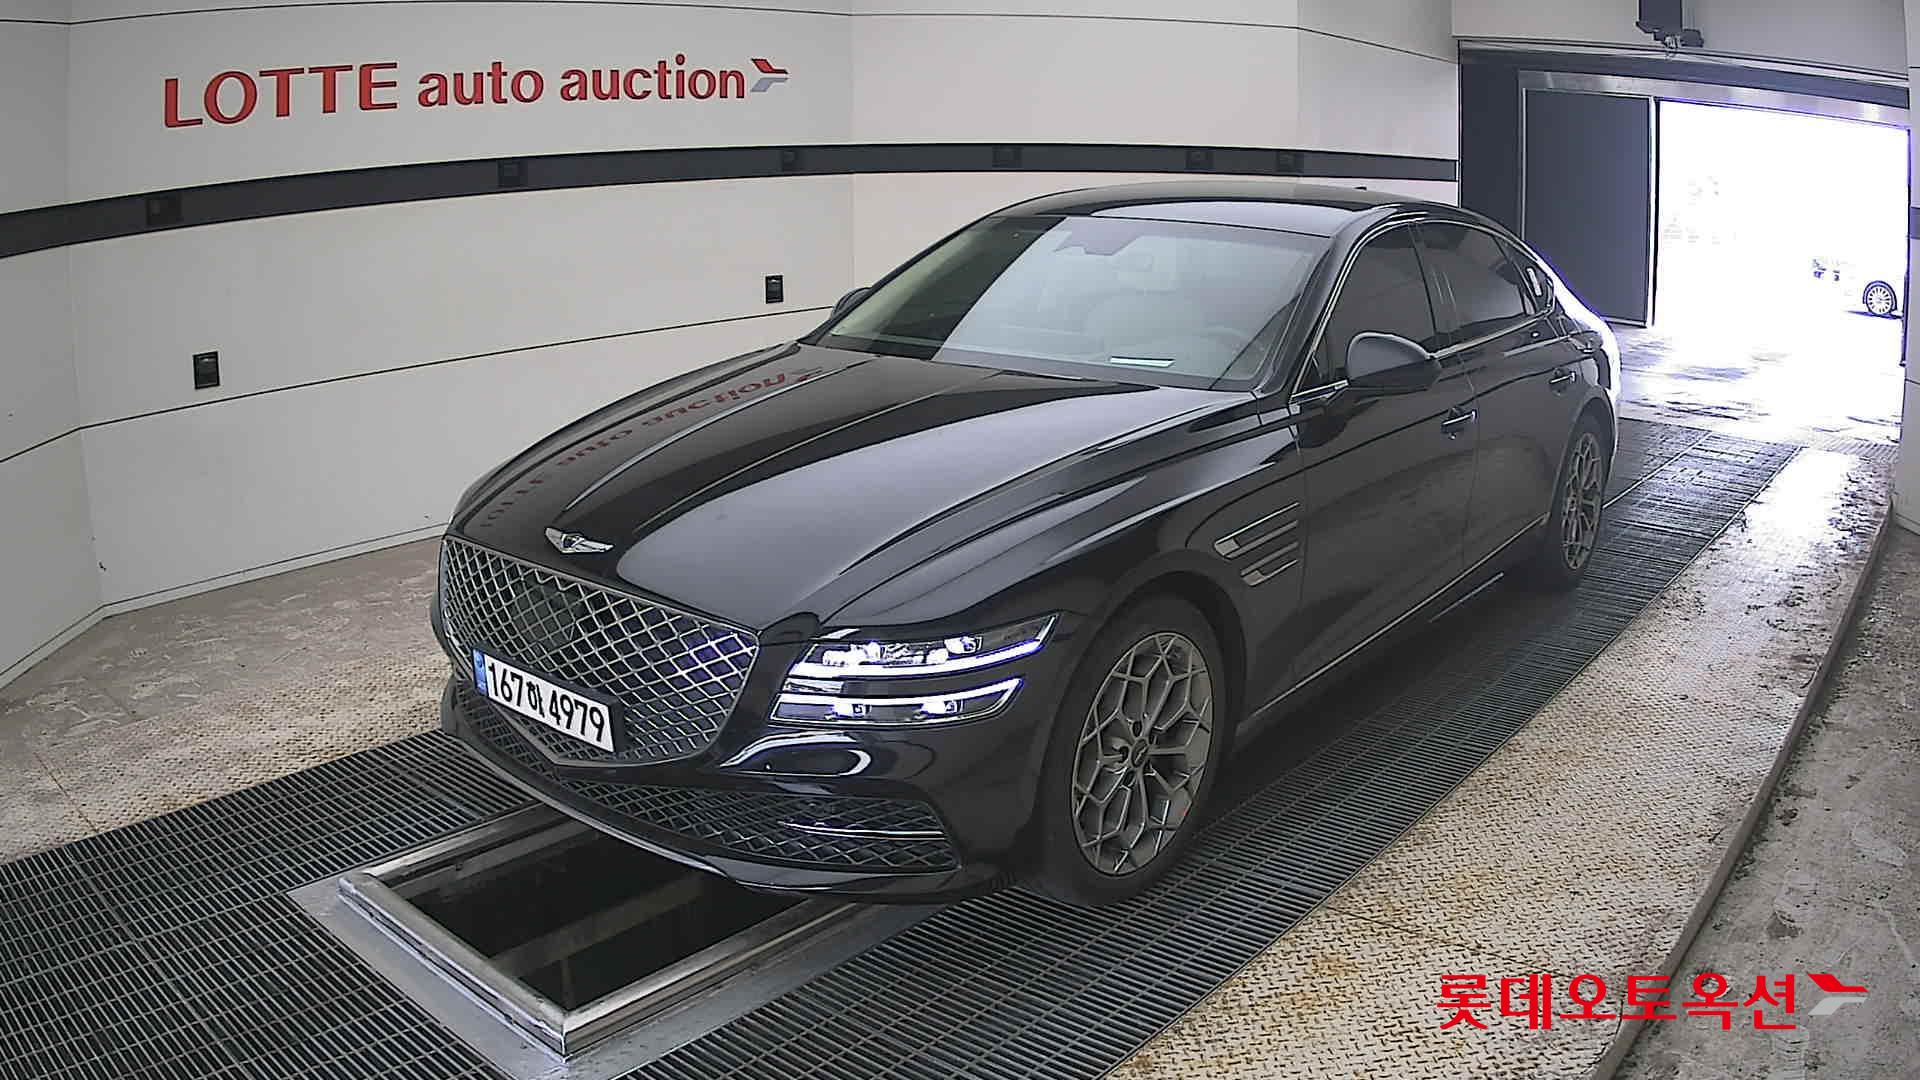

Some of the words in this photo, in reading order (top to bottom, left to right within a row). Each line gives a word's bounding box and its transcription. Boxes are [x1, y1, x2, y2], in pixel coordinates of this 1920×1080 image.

[164, 62, 399, 128] LOTTE
[417, 62, 545, 108] auto
[560, 54, 746, 102] auction
